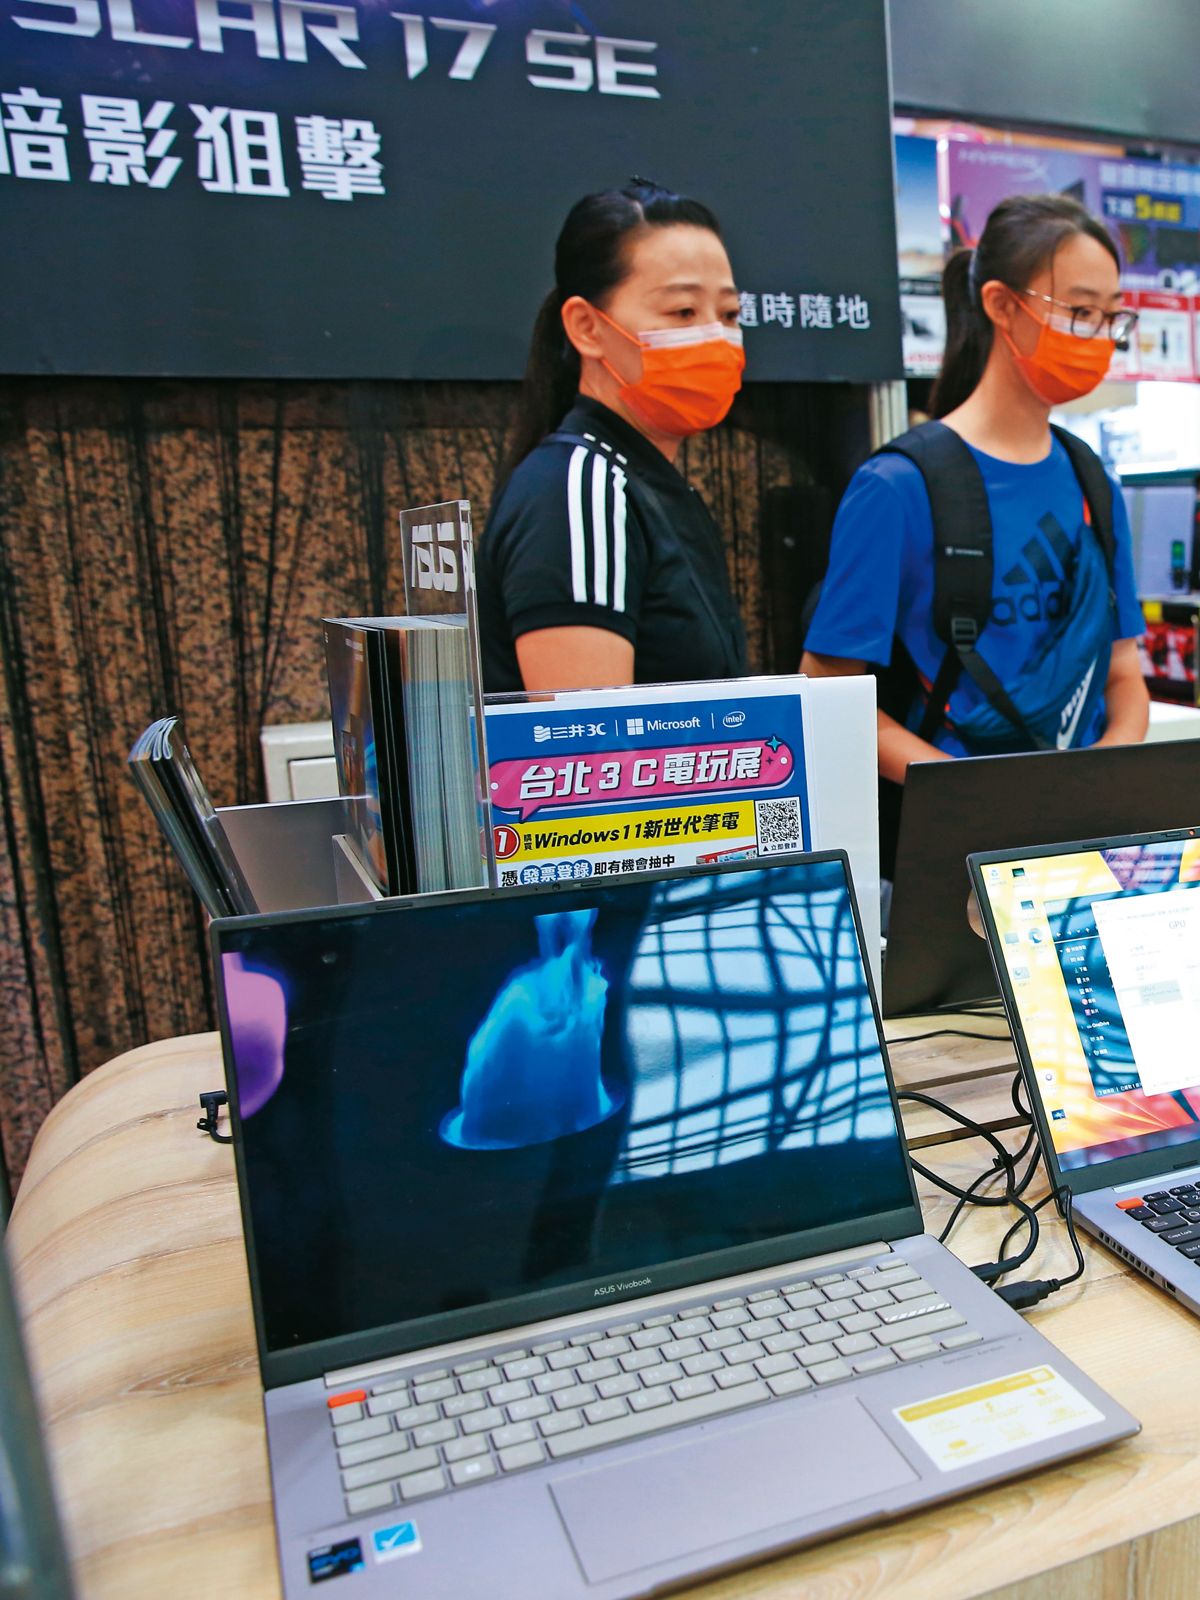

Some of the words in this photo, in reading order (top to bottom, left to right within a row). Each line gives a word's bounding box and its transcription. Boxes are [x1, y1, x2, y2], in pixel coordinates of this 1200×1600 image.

[390, 11, 498, 81] 17
[525, 28, 661, 99] SE
[0, 86, 386, 201] 暗影狙擊
[411, 521, 458, 593] ASUS
[647, 716, 701, 731] Microsoft
[724, 713, 744, 726] intel
[1168, 919, 1186, 930] GPU
[593, 1284, 616, 1297] ASUS
[616, 1277, 652, 1291] Vivobook
